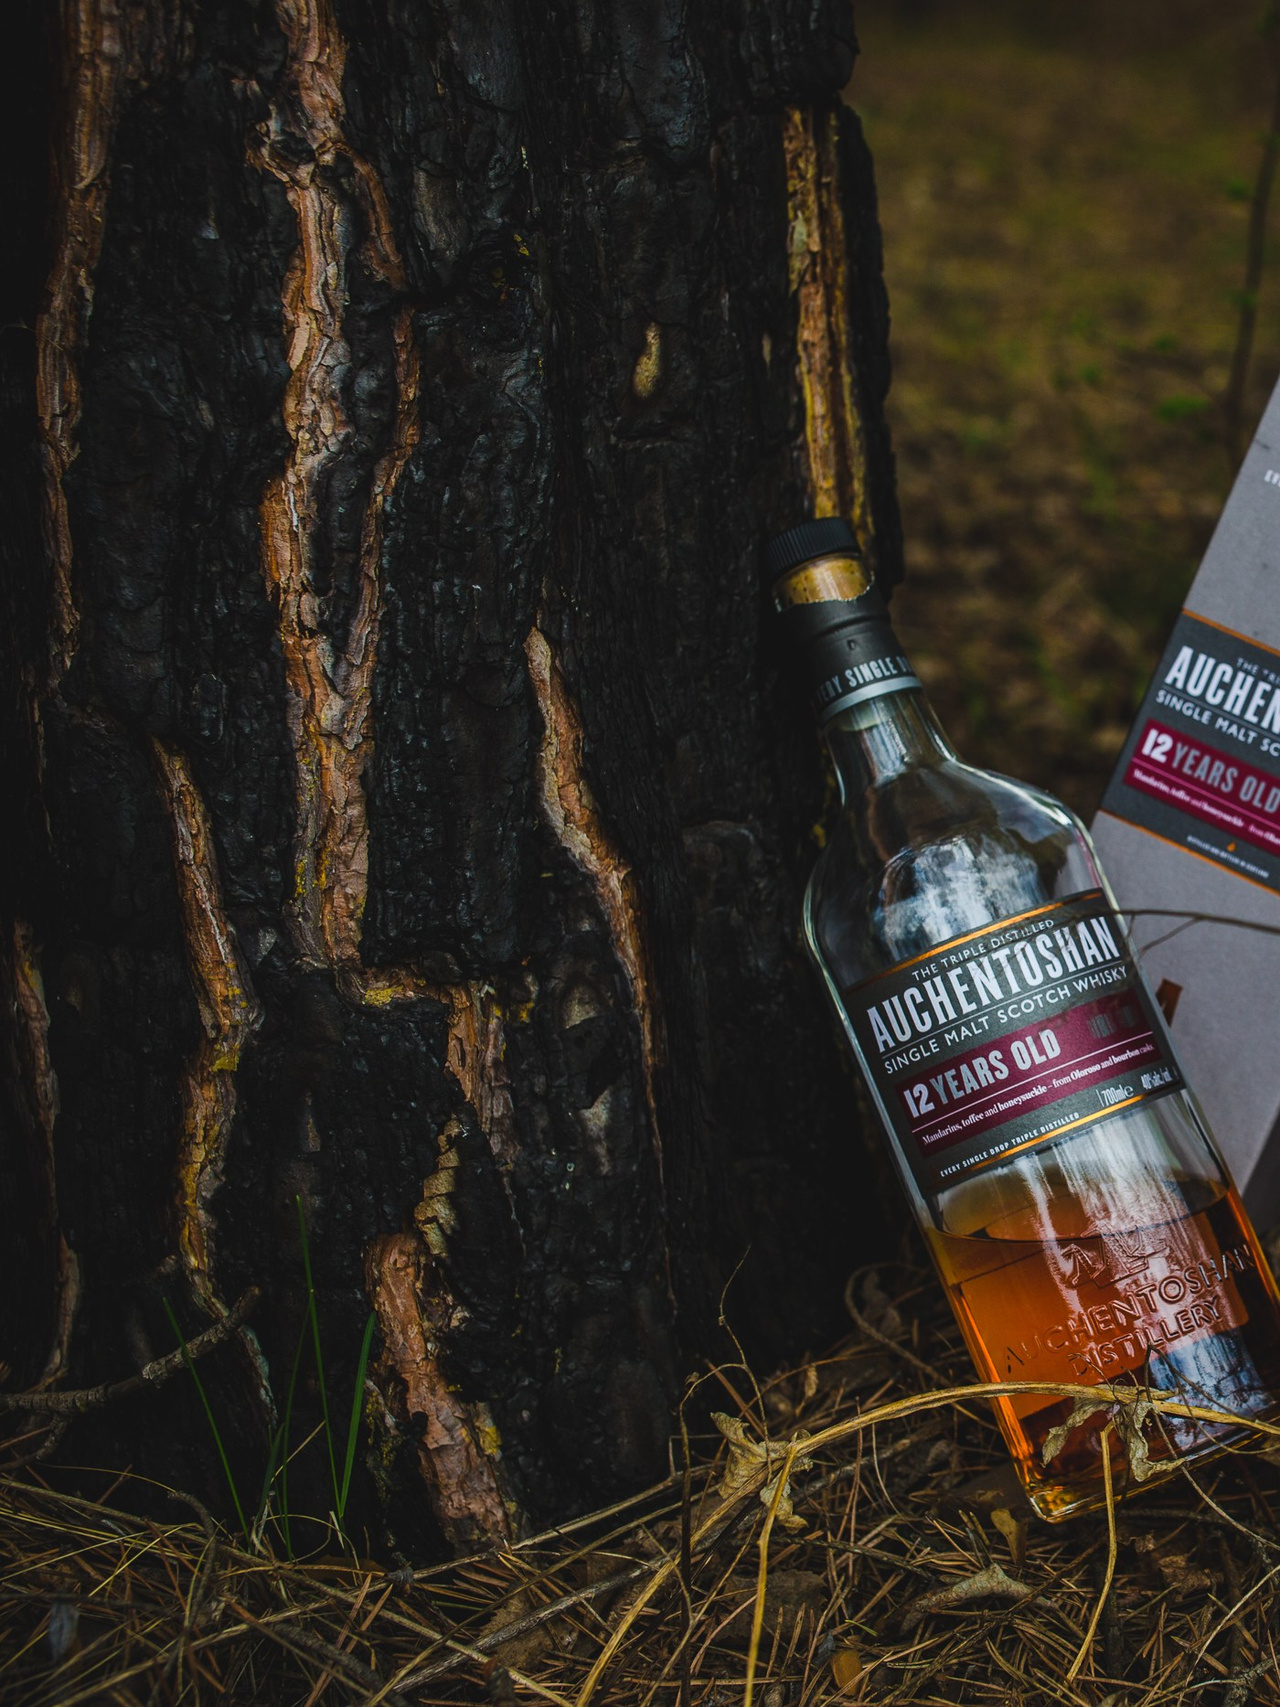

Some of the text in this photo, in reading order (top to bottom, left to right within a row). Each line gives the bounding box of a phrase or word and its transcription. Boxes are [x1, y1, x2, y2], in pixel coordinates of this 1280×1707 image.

[844, 657, 898, 687] SINGLE
[1237, 657, 1260, 675] THE
[1156, 689, 1210, 725] SINGLE
[1214, 717, 1257, 745] MALT
[1141, 728, 1174, 763] 12
[1173, 742, 1239, 793] YEARS
[867, 916, 1121, 1053] AUCHENTOSHAN
[912, 919, 1055, 982] THE TRIPLE DISTILLED
[884, 965, 1129, 1074] SINGLE MALT SCOTCH WHISKY
[904, 1028, 1062, 1119] 12 YEARS OLD
[922, 1124, 963, 1146] Mandarins,
[962, 1111, 984, 1128] toffee
[984, 1104, 999, 1118] and
[998, 1084, 1048, 1111] honeysuckle
[1052, 1076, 1072, 1089] from
[1070, 1063, 1102, 1082] Oloroso
[1100, 1057, 1114, 1069] and
[1112, 1049, 1140, 1065] bourbon
[940, 1112, 1080, 1179] EVERY SINGLE DROP TRIPLE DISTILLED
[1004, 1244, 1256, 1375] AUCHENTOSHAN
[1071, 1295, 1222, 1377] DISTILLERY
